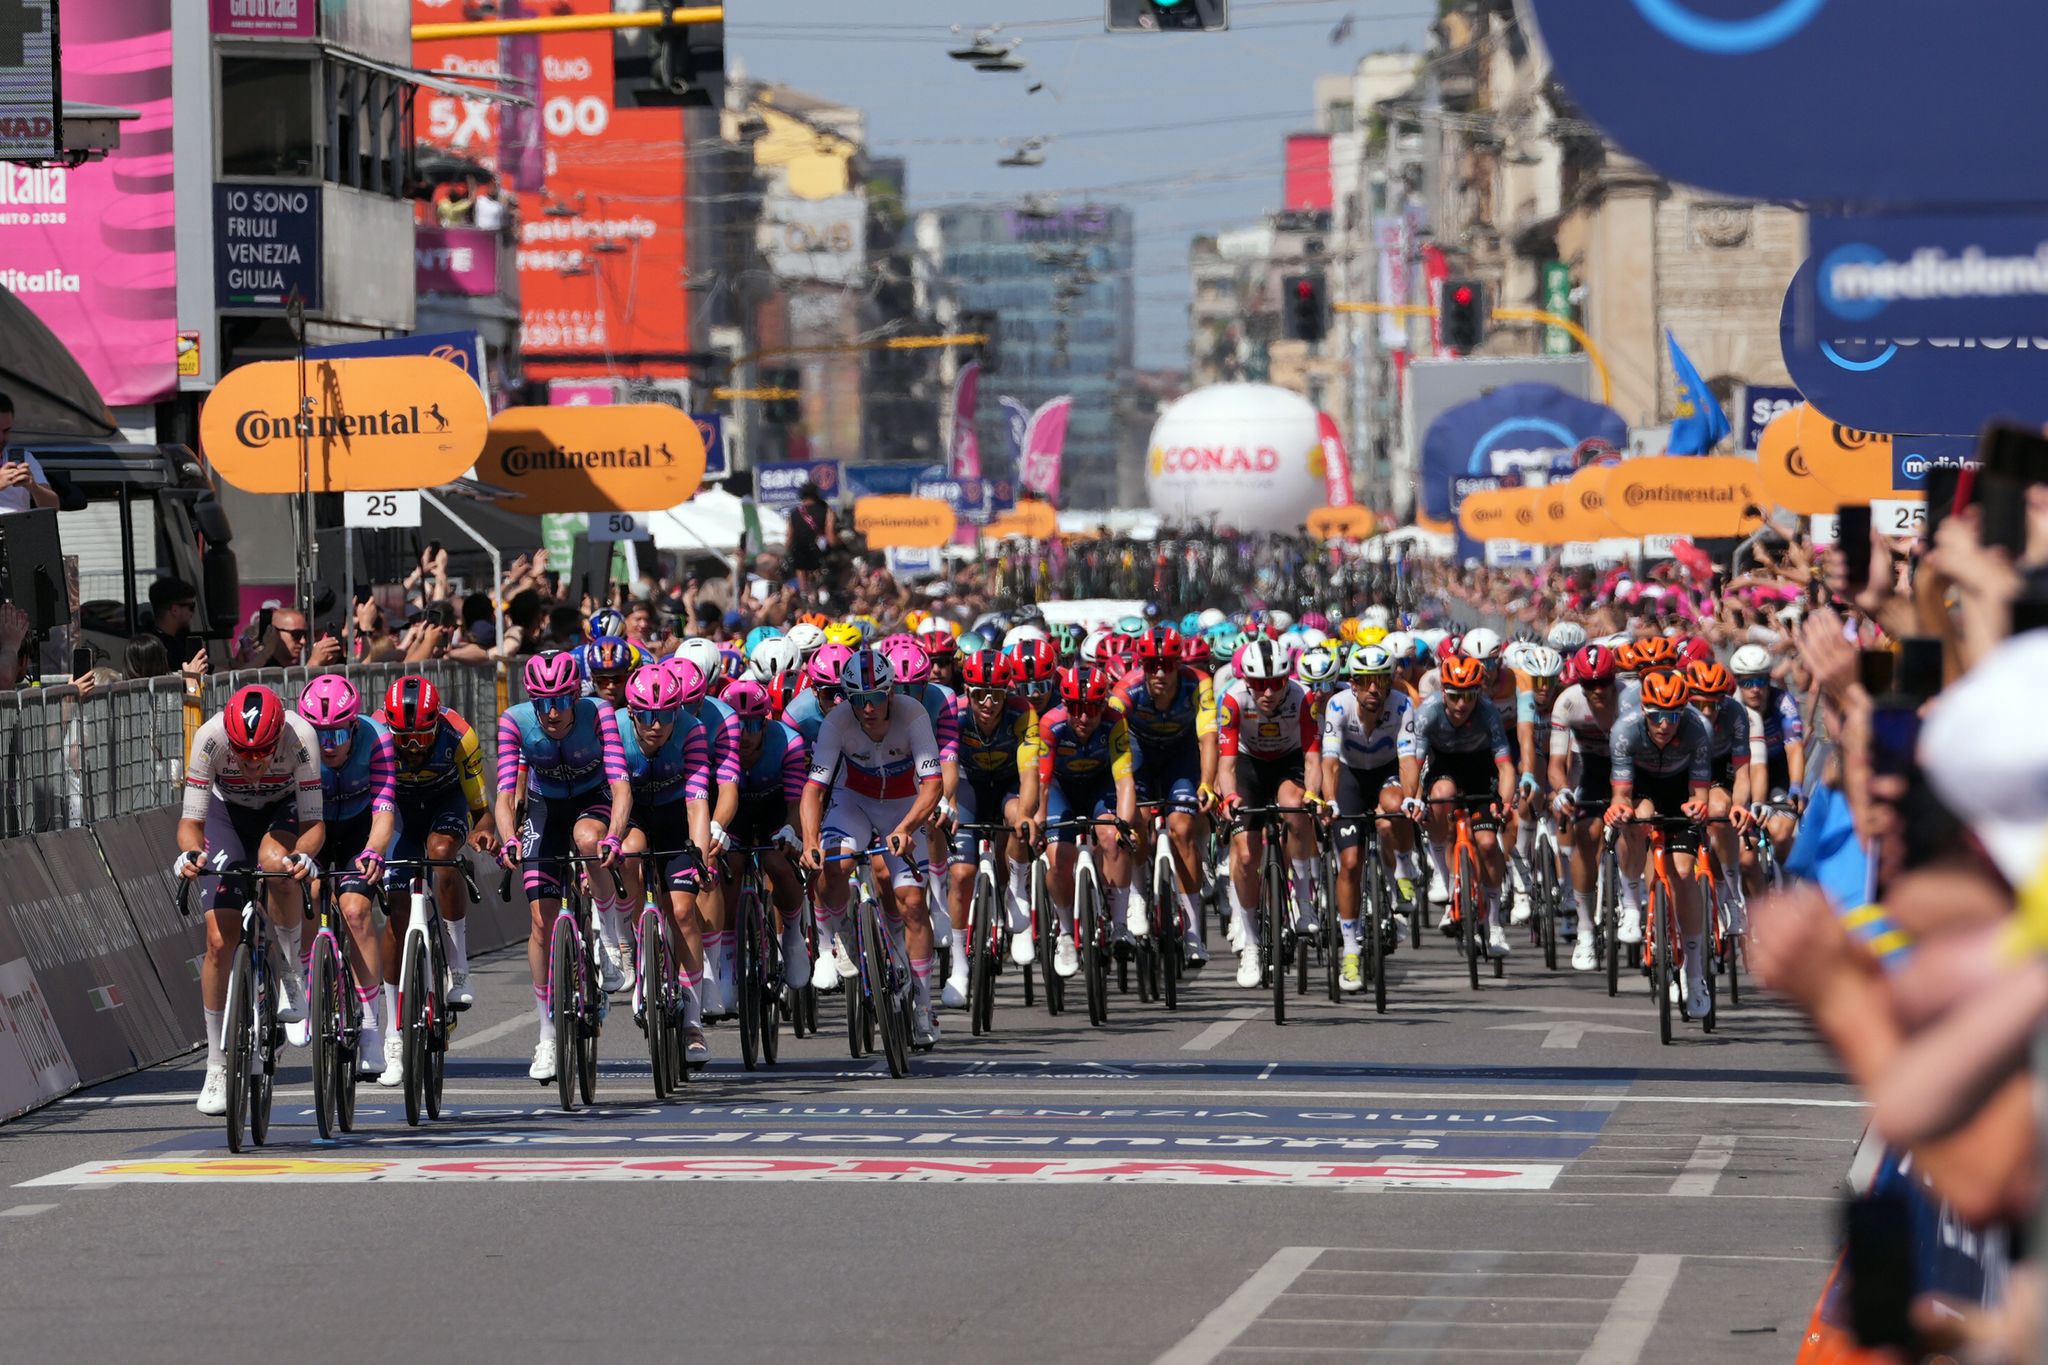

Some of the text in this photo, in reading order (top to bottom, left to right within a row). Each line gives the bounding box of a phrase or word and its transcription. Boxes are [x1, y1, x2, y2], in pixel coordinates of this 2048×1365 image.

[227, 191, 308, 214] IO SONO
[32, 212, 67, 225] 2026
[227, 217, 278, 238] FRIULI
[227, 243, 302, 265] VENEZIA
[228, 268, 286, 289] GIULIA
[235, 406, 420, 449] Continental
[500, 445, 652, 477] Continental
[1165, 446, 1280, 473] CONAD
[1623, 482, 1734, 507] Continental
[366, 496, 398, 517] 25
[608, 514, 635, 533] 50
[1894, 507, 1927, 529] 25
[1831, 521, 1841, 539] 5
[938, 1108, 1270, 1118] VENEZIA
[1297, 1112, 1558, 1123] GIULIA
[366, 1132, 1441, 1149] mediolanum
[417, 1159, 1524, 1179] CONAD
